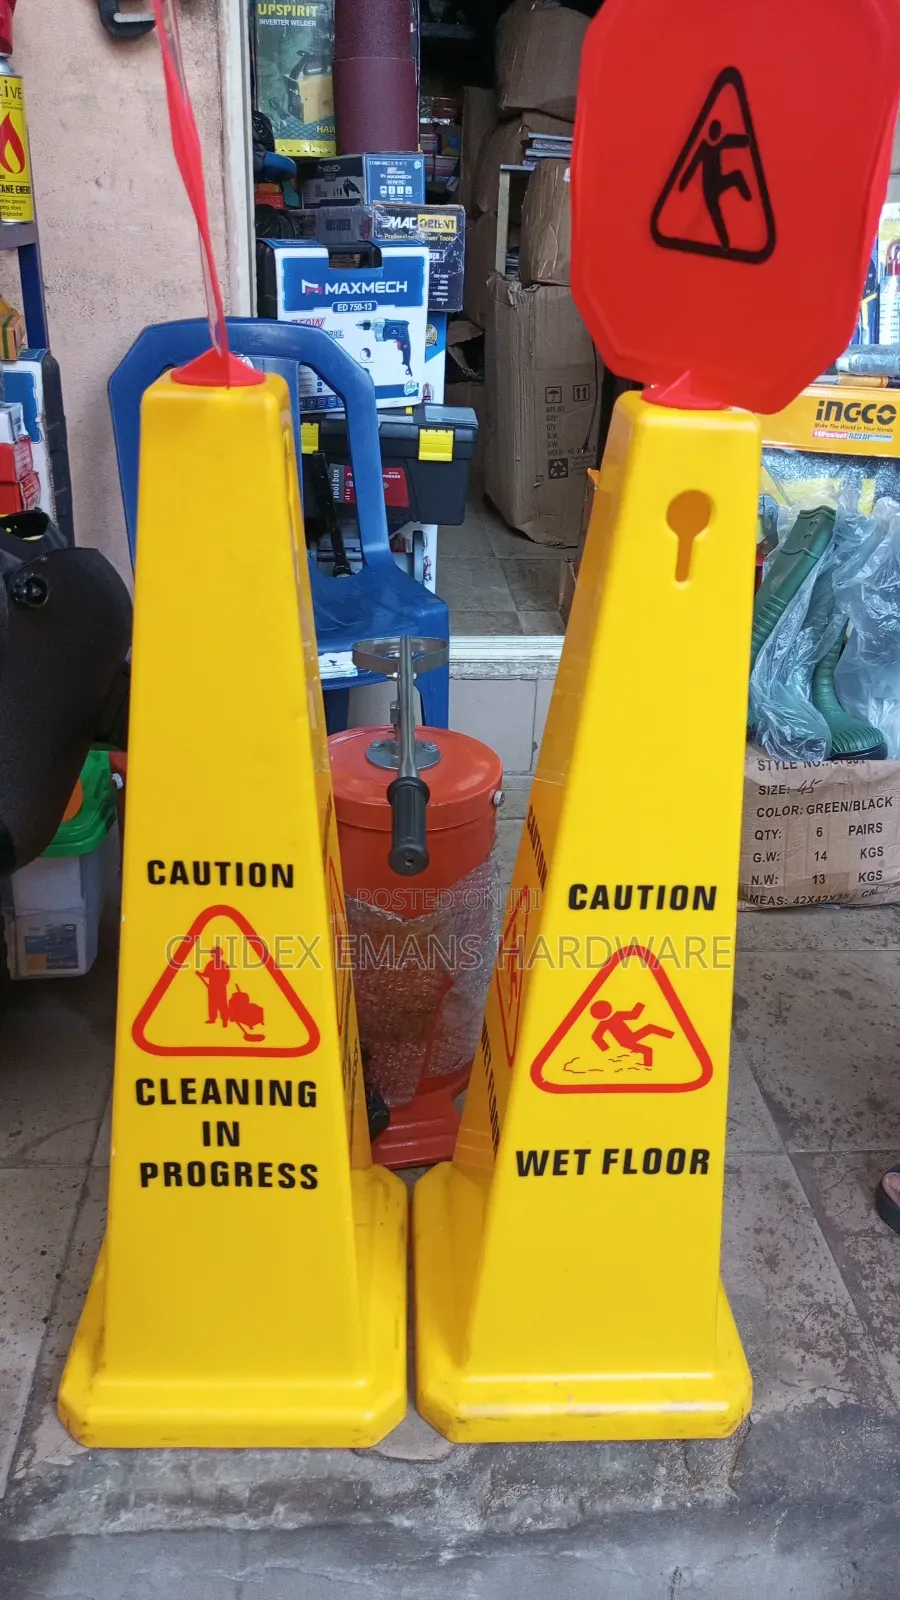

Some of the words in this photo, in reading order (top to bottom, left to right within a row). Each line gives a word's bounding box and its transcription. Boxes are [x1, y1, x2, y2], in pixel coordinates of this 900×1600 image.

[258, 4, 318, 17] UPSPIRIT
[420, 218, 455, 230] ORIENT
[325, 281, 408, 294] MAXMECH
[337, 304, 348, 312] ED
[349, 303, 372, 311] 750-13
[757, 760, 797, 771] STYLE
[758, 785, 790, 796] SIZE:
[756, 805, 803, 818] COLOR:
[806, 796, 894, 815] GREEN/BLACK
[754, 829, 782, 841] QTY:
[816, 827, 823, 838] 6
[848, 822, 883, 836] PAIRS
[753, 852, 780, 863] G.W:
[814, 851, 828, 862] 14
[860, 846, 884, 860] KGS
[147, 859, 294, 889] CAUTION
[751, 875, 779, 886] N.W:
[812, 874, 826, 885] 13
[858, 870, 883, 883] KGS
[568, 883, 717, 911] CAUTION
[749, 894, 788, 906] MEAS:
[135, 1078, 317, 1108] CLEANING
[202, 1120, 240, 1147] IN
[515, 1148, 592, 1177] WET
[601, 1147, 711, 1176] FLOOR
[139, 1161, 319, 1190] PROGRESS
